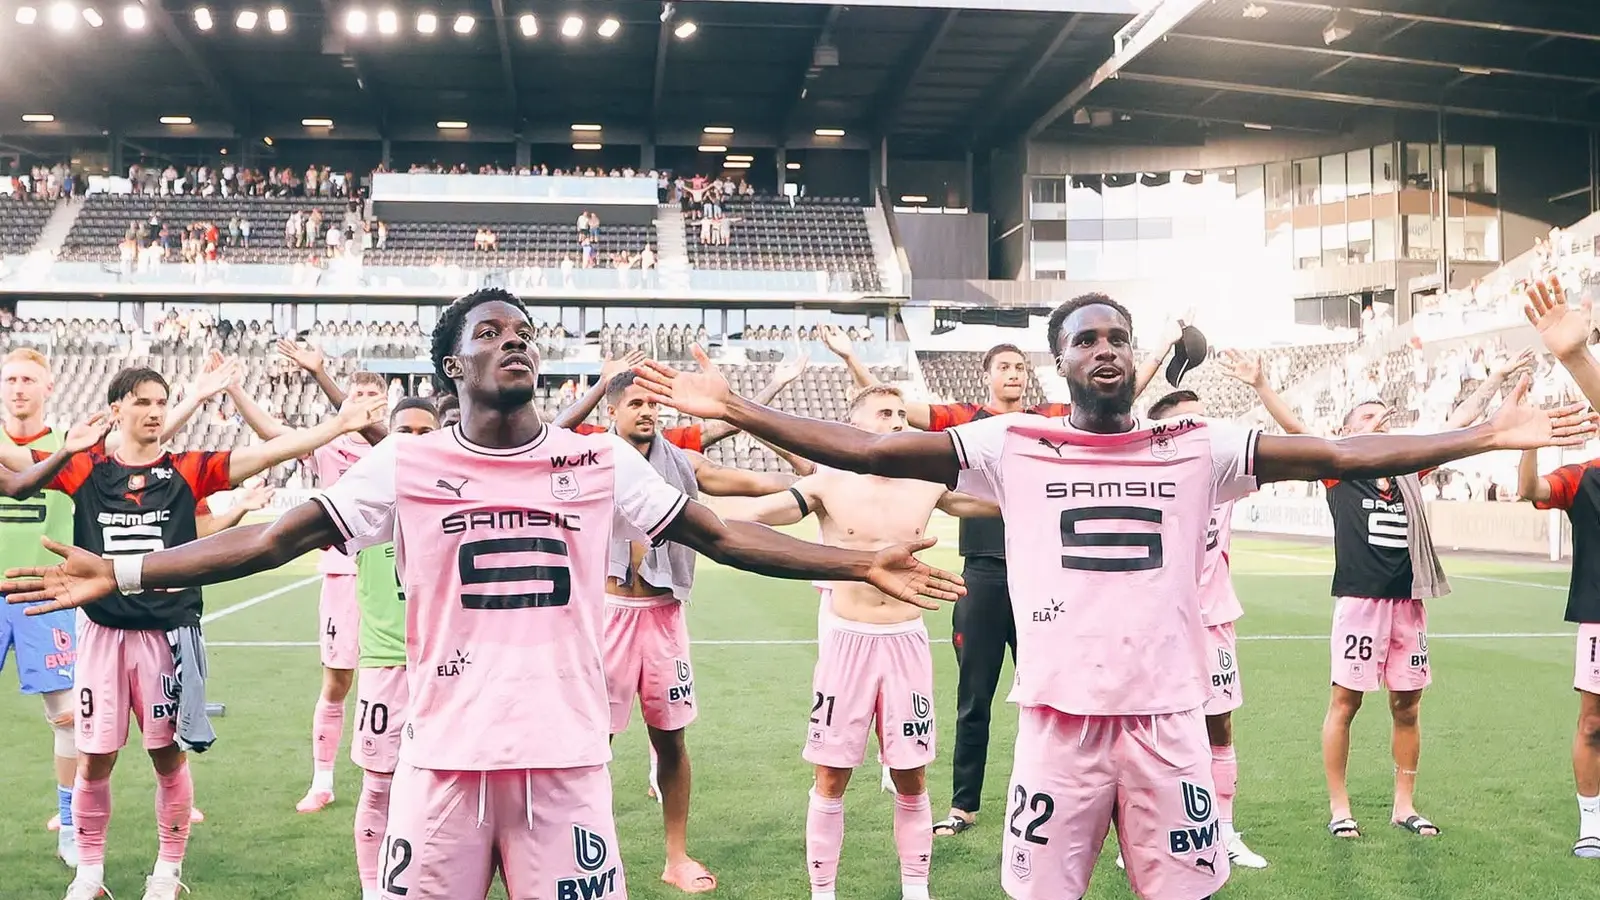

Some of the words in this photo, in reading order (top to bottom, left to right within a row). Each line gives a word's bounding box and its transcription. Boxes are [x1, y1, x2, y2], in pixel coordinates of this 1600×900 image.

[1045, 481, 1176, 498] SAMSIC
[96, 510, 171, 526] SAMSIC
[441, 510, 581, 535] SAMSIC
[326, 616, 337, 641] 4
[1032, 611, 1052, 623] ELA
[1343, 634, 1373, 661] 26
[437, 664, 460, 677] ELA
[80, 687, 94, 718] 9
[809, 691, 836, 727] 21
[359, 699, 388, 735] 70
[1010, 784, 1055, 846] 22
[382, 834, 412, 896] 12
[557, 866, 617, 900] BWT
